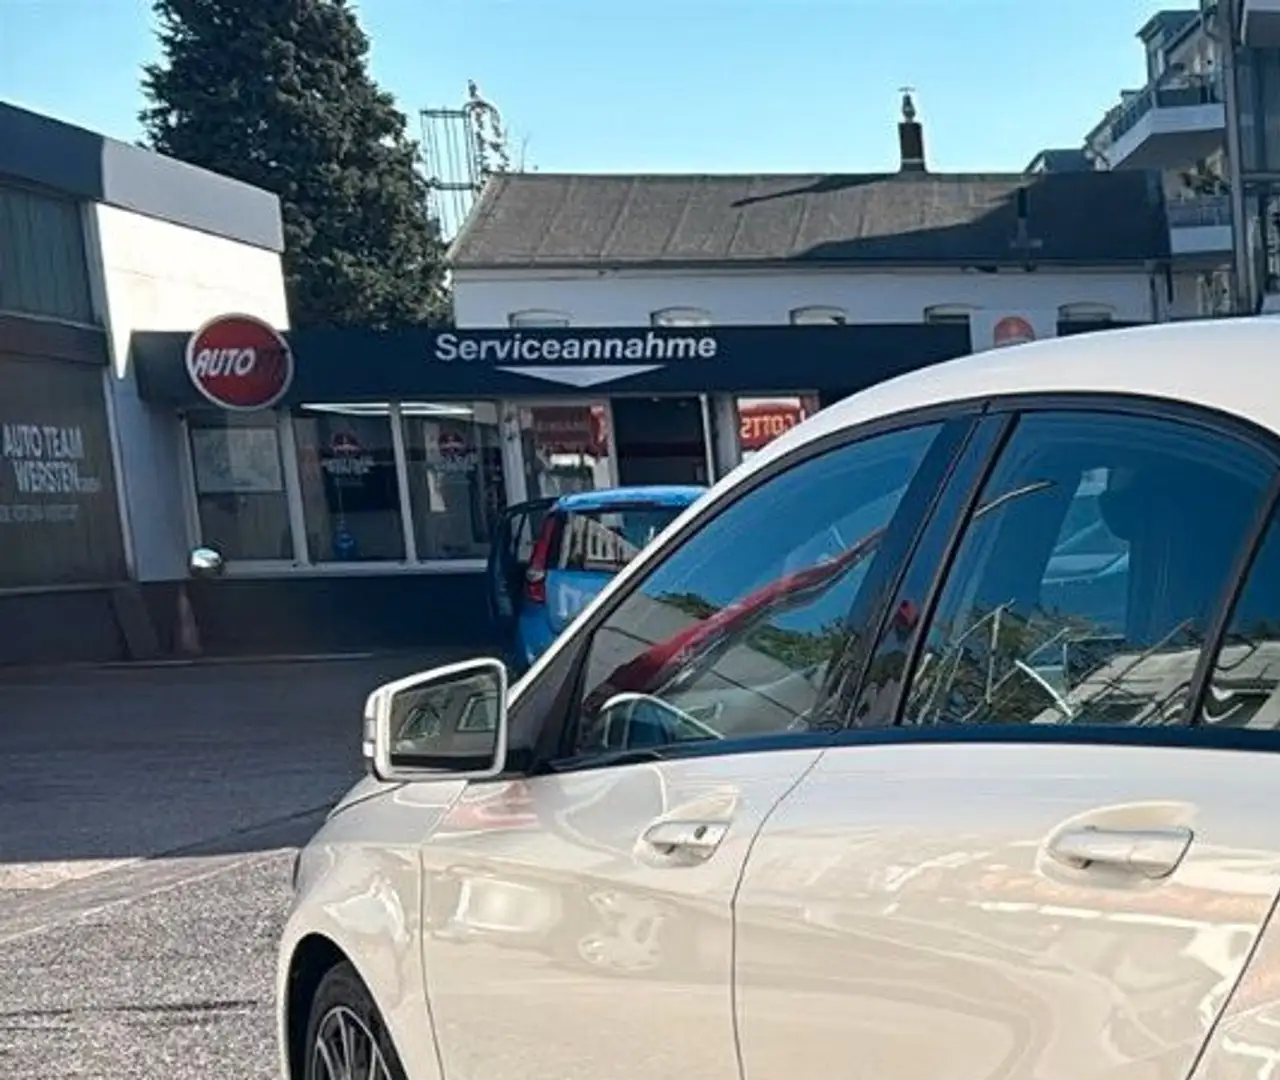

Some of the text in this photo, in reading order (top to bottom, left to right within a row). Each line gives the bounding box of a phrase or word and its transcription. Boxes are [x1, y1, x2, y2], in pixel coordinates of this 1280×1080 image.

[435, 331, 718, 361] Serviceannahme
[3, 424, 84, 460] AUTO TEAM
